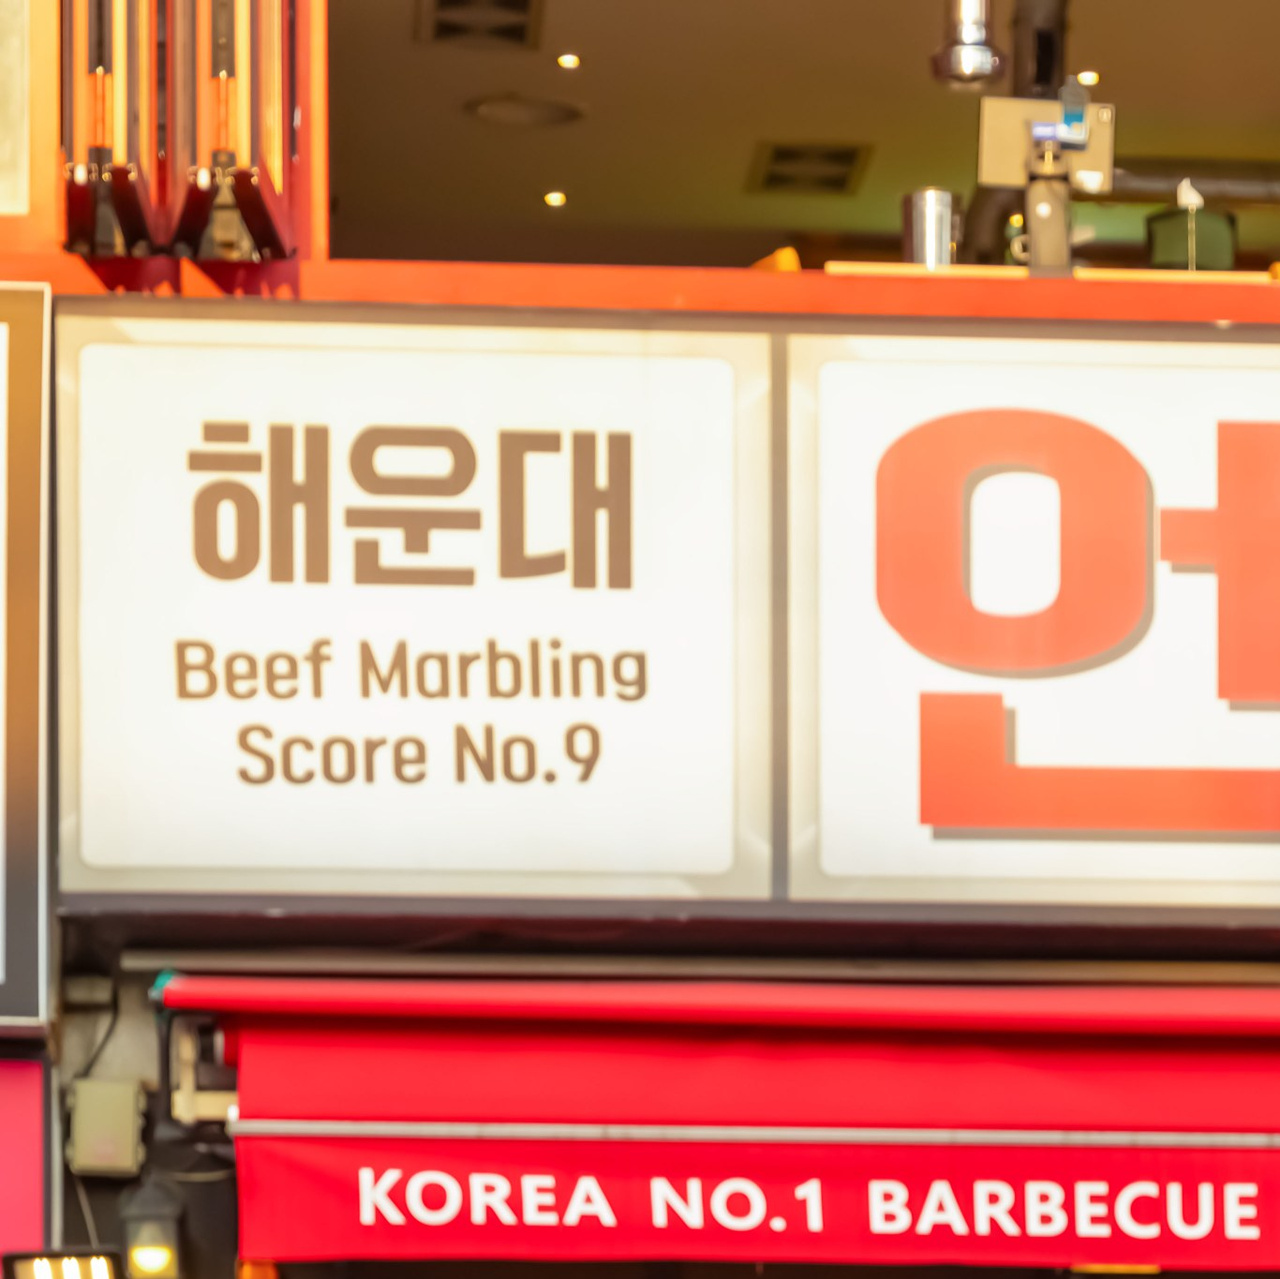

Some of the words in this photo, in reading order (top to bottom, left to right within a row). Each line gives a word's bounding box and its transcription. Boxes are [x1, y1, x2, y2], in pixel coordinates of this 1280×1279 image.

[187, 421, 634, 590] 해운대
[174, 639, 332, 701] Beef
[360, 638, 648, 702] Marbling
[237, 724, 428, 785] Score
[455, 724, 602, 784] No.9
[358, 1167, 617, 1228] KOREA
[650, 1175, 824, 1233] NO.1
[868, 1179, 1261, 1241] BARBECUE
